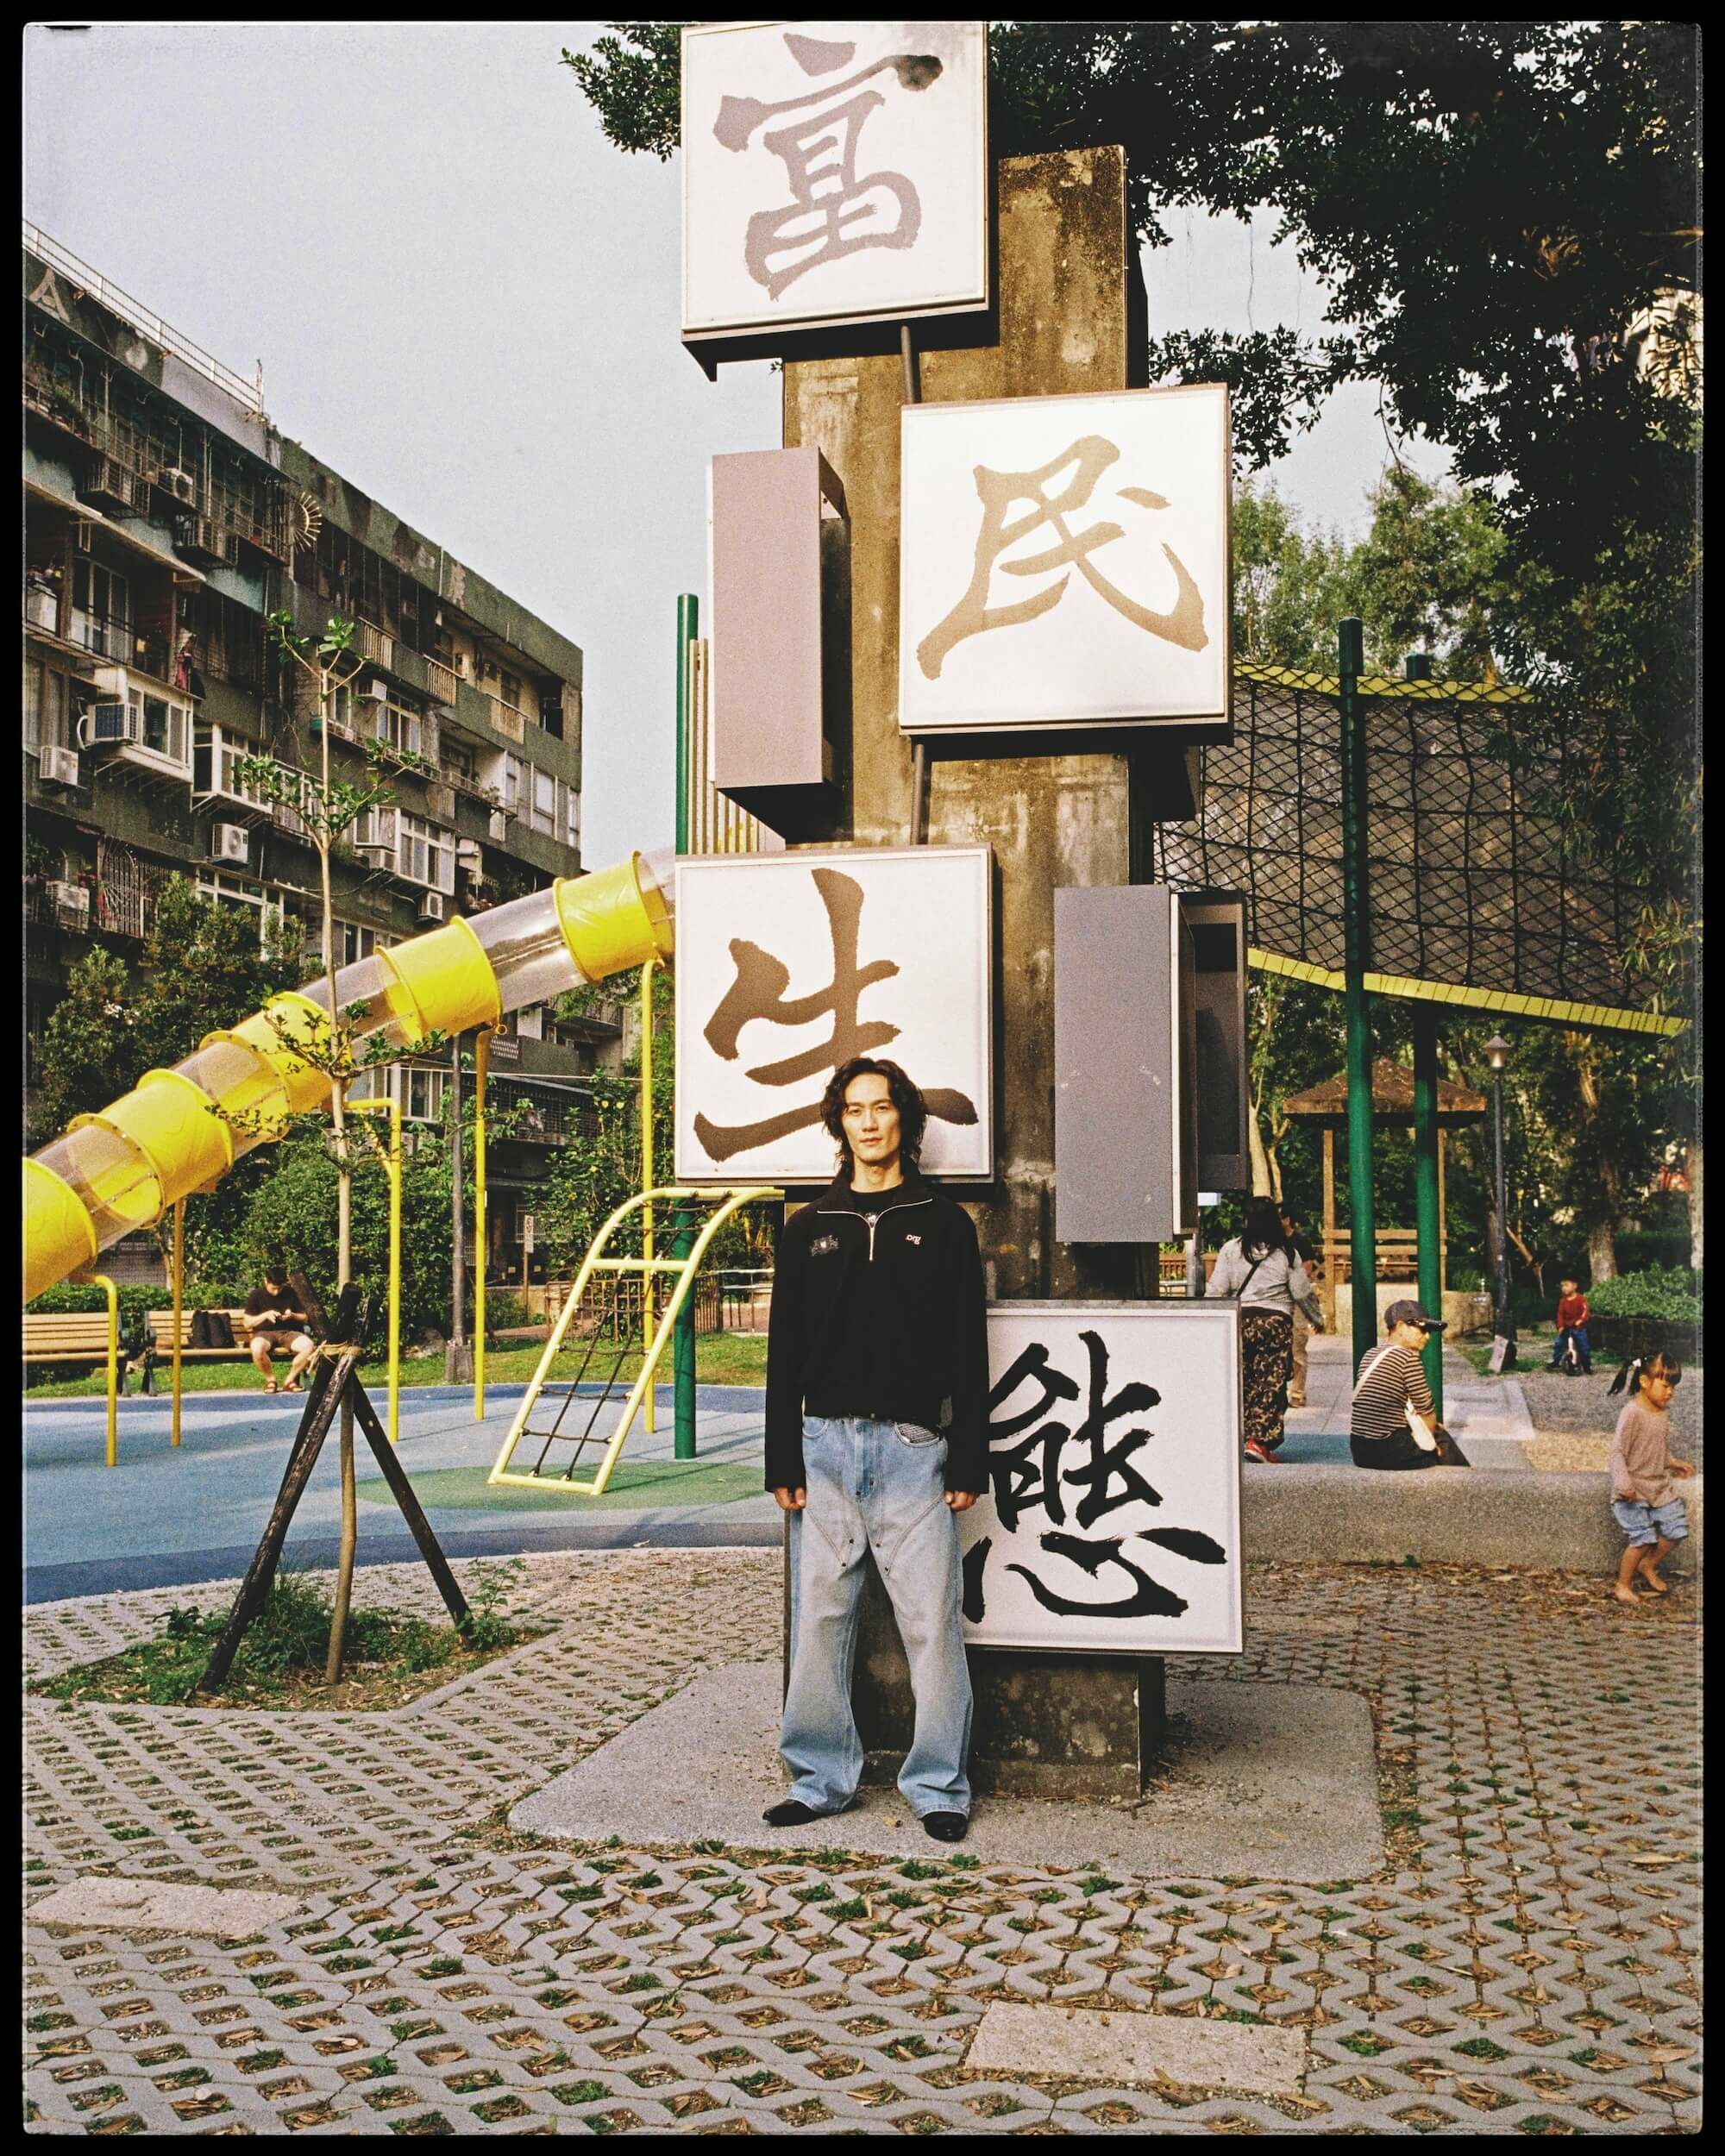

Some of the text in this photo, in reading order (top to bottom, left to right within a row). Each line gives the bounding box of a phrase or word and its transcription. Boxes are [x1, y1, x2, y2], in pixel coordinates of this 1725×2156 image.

[712, 32, 944, 301] 富
[916, 434, 1209, 680] 民
[693, 867, 980, 1163] 生
[962, 1330, 1228, 1624] 態
